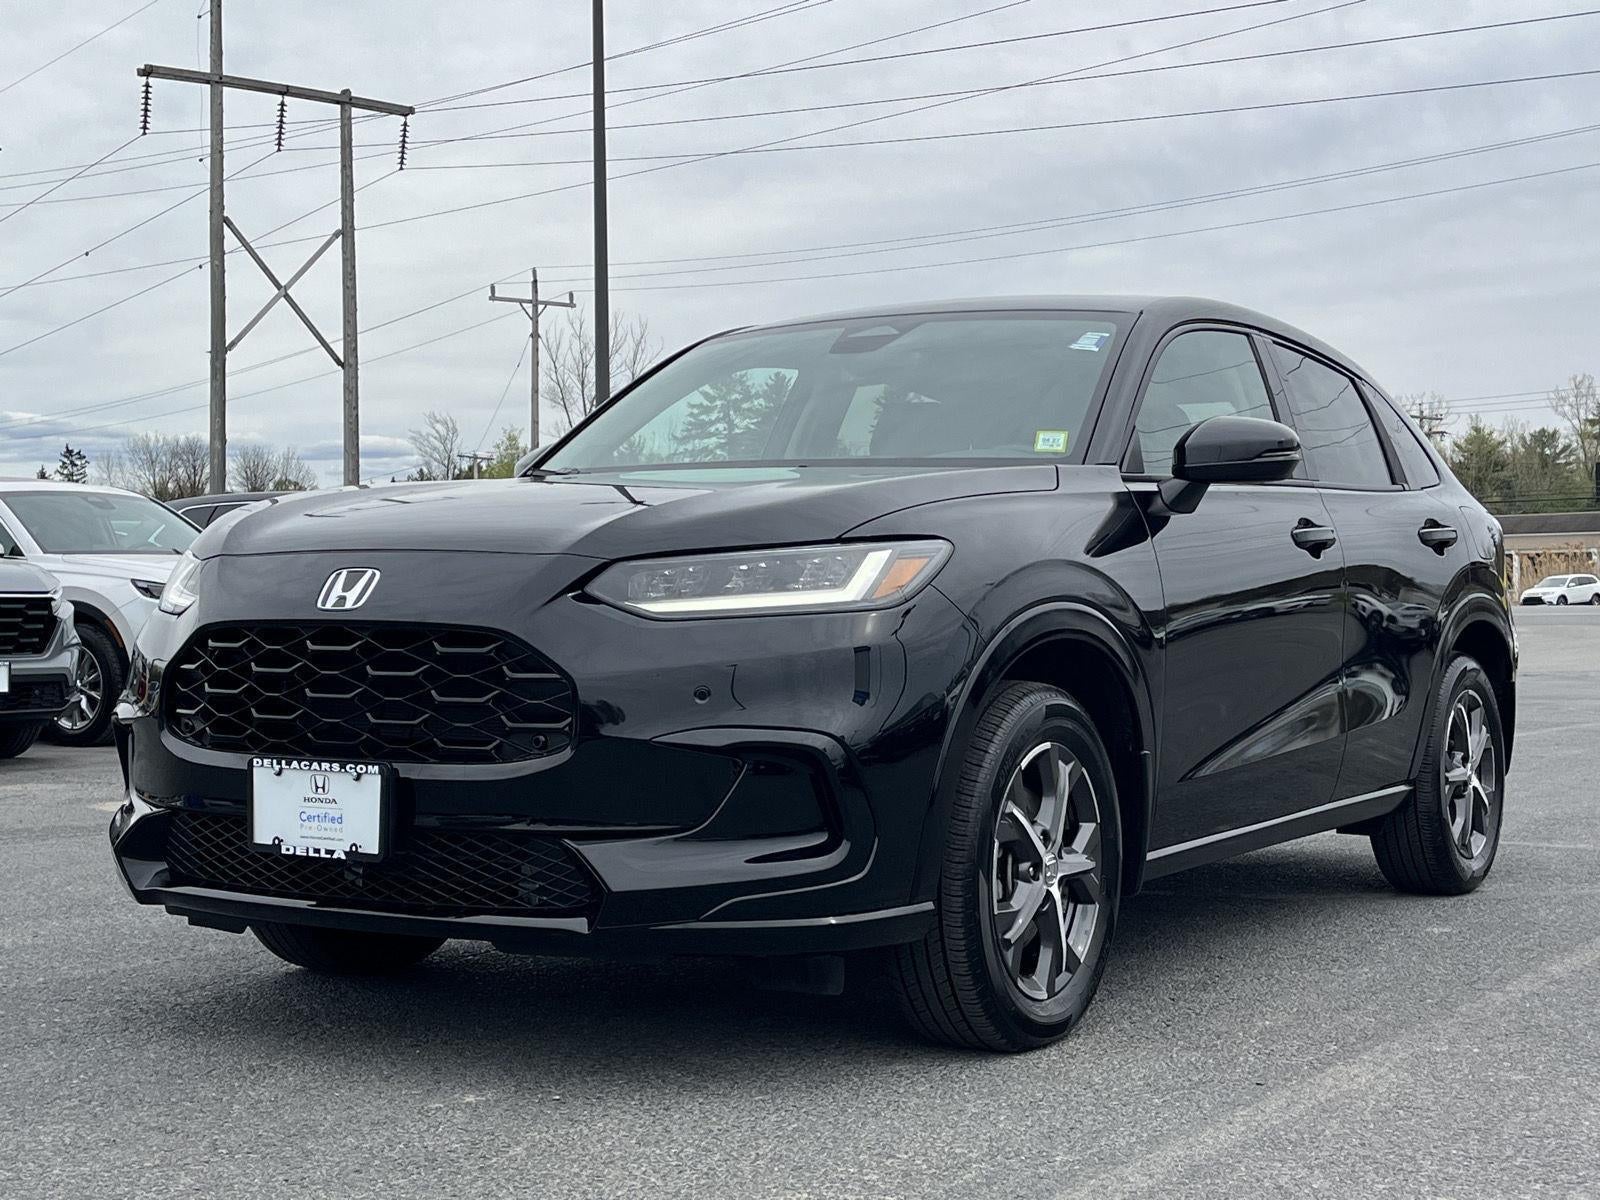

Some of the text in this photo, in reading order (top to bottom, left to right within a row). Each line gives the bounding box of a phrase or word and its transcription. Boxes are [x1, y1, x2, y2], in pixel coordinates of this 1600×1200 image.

[253, 758, 379, 775] DELLACARS.COM
[303, 796, 338, 805] HONDA
[300, 811, 343, 824] Certified
[281, 845, 347, 860] DELLA
